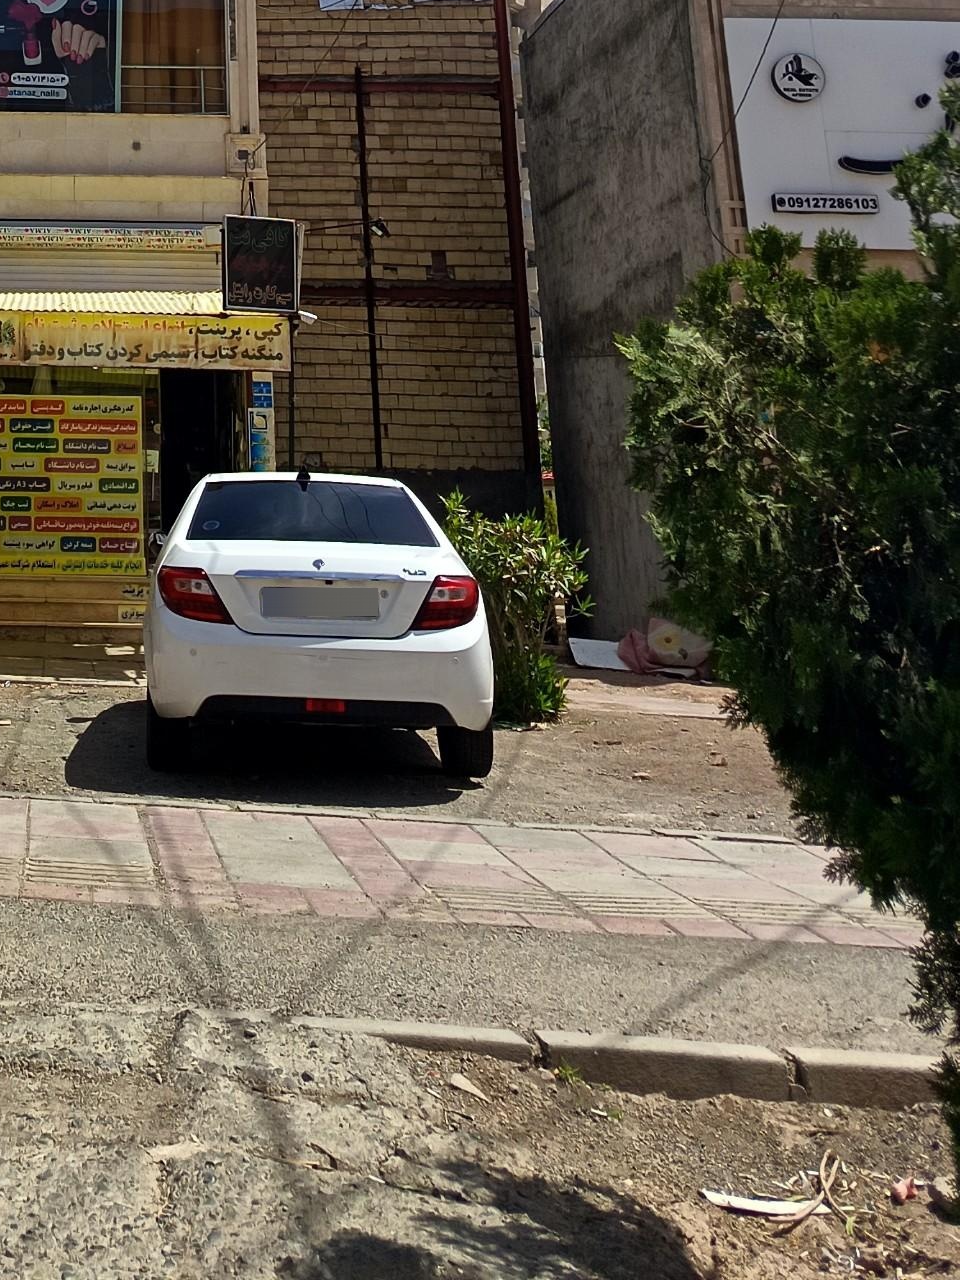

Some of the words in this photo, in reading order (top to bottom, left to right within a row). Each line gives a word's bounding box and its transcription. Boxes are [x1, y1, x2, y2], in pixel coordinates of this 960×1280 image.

[787, 196, 878, 210] 09127286103
[254, 322, 283, 342] کپی
[23, 340, 55, 361] دفتر
[55, 347, 65, 360] و
[66, 342, 104, 361] کتاب
[106, 344, 143, 362] کردن
[146, 350, 190, 363] سیمی
[201, 345, 239, 362] کتاب
[241, 345, 283, 360] منگنه
